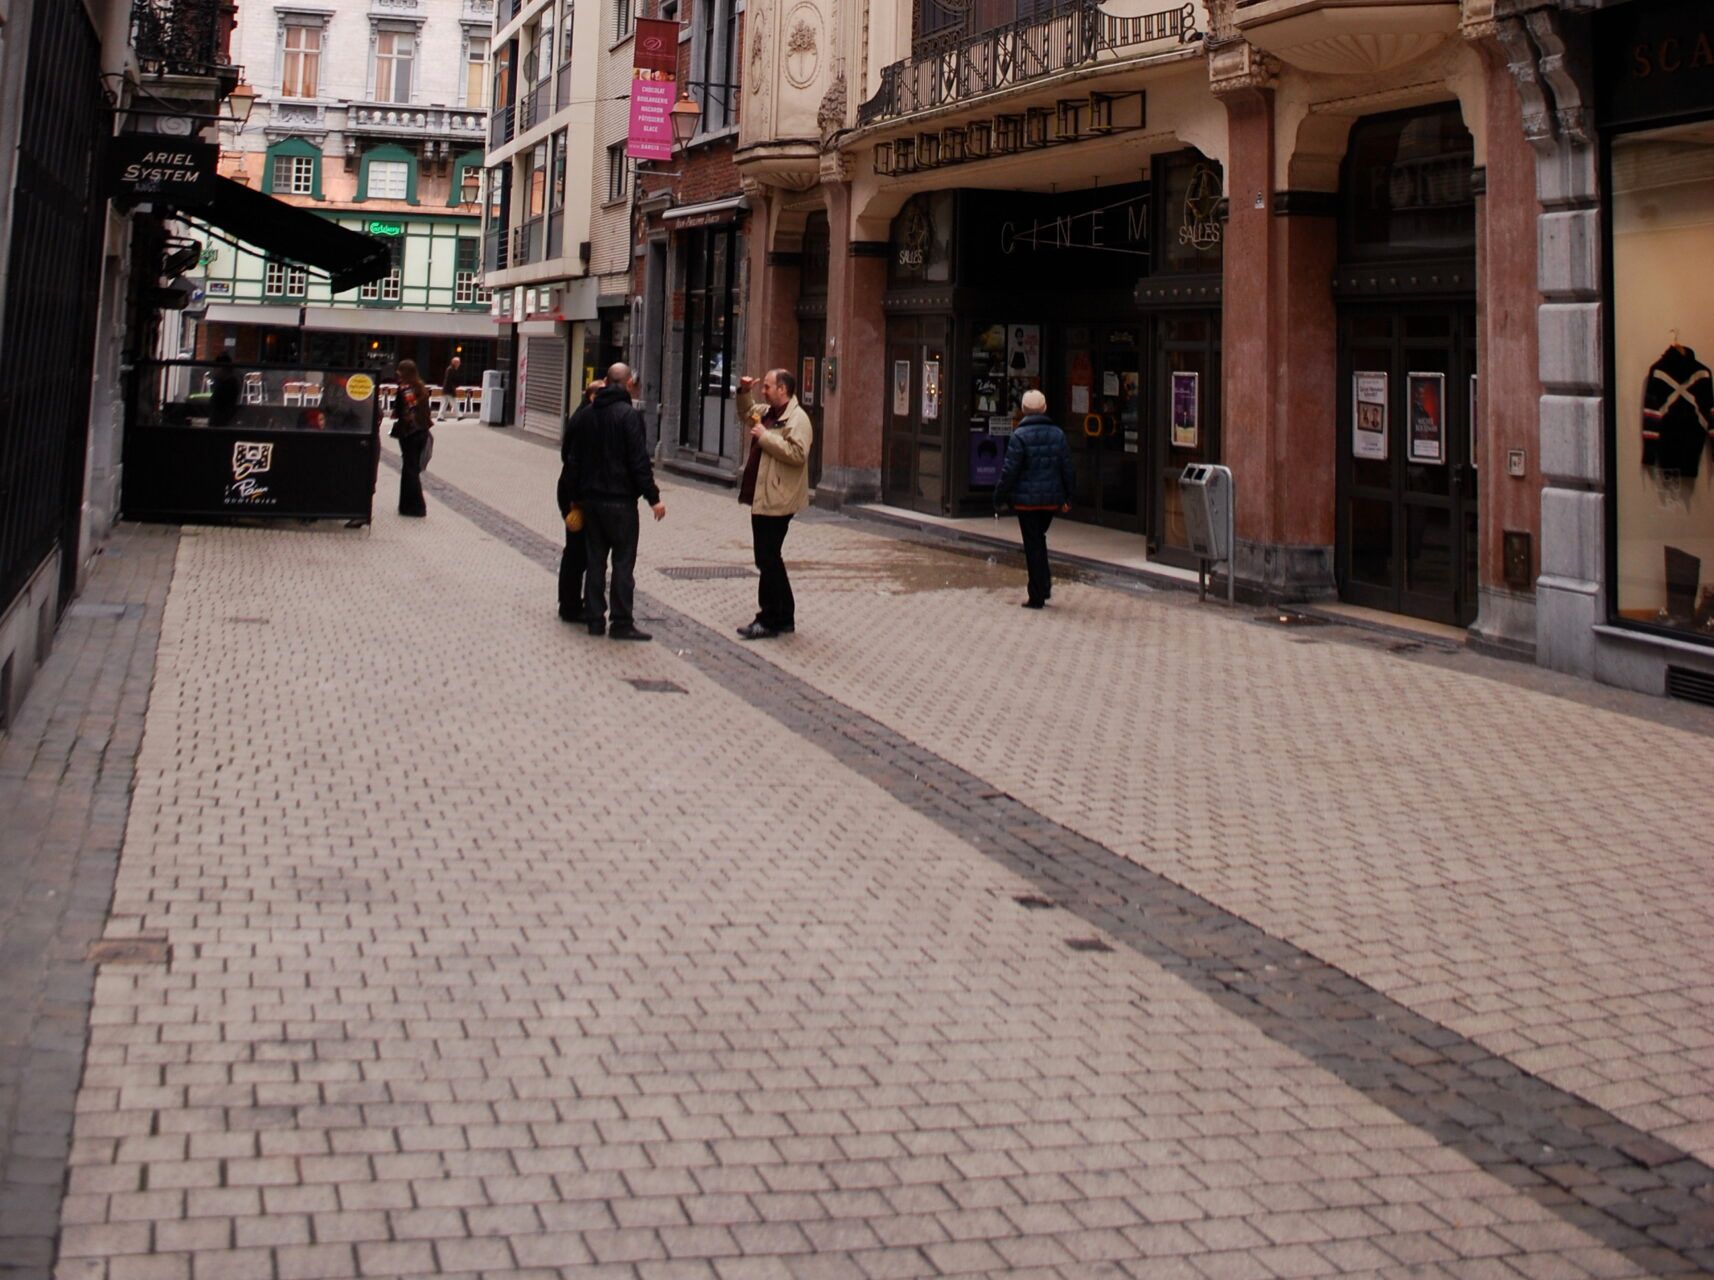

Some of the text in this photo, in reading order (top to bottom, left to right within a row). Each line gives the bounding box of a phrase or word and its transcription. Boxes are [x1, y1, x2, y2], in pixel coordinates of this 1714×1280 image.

[641, 86, 665, 95] CHOCOLAT
[643, 125, 659, 133] GLACE
[142, 152, 195, 167] ARIEL
[121, 164, 200, 183] SYSTEM
[1178, 222, 1221, 246] SALLES
